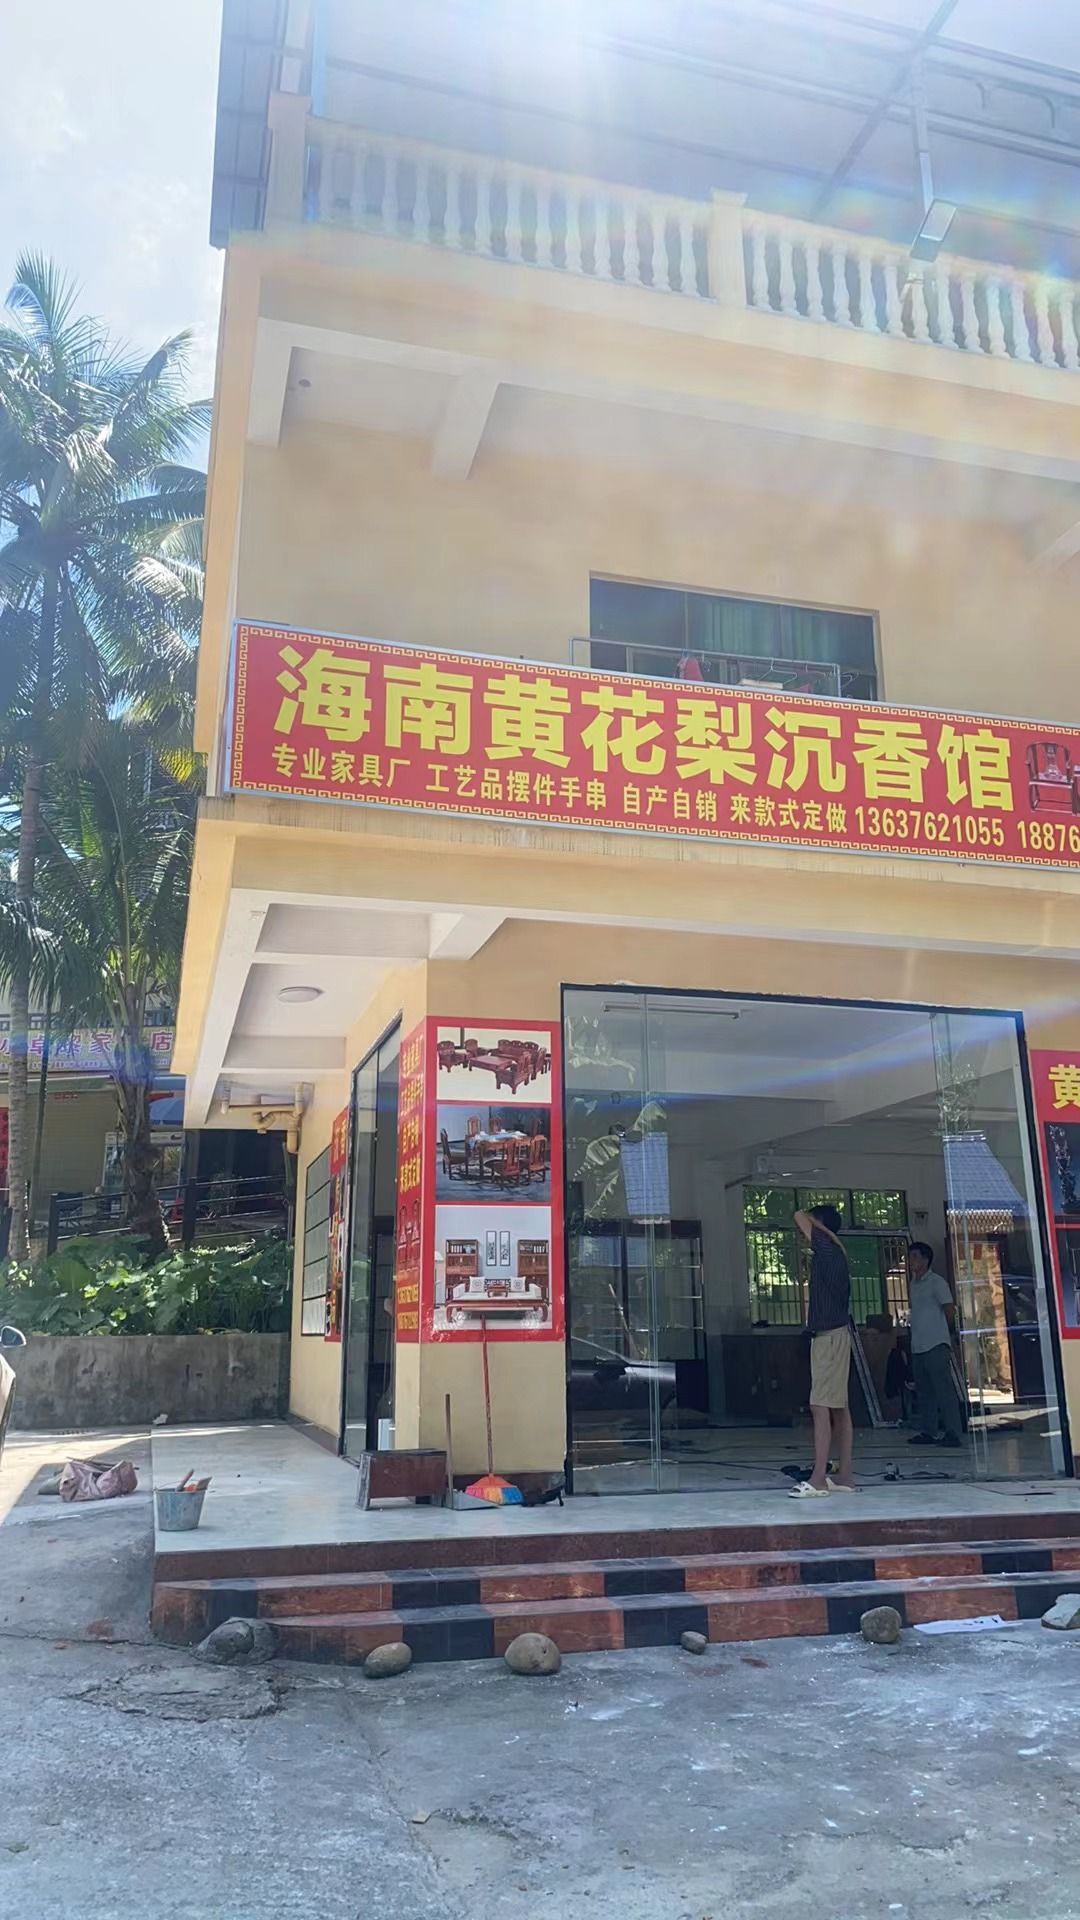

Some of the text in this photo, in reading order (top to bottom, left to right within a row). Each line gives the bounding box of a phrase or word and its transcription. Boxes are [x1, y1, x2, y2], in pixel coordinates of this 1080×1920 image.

[272, 743, 411, 788] 专业家具厂
[426, 763, 607, 811] 工艺品摆件手串
[623, 782, 717, 822] 自产自销
[730, 793, 847, 834] 来款式定做
[855, 806, 1005, 847] 13637621055
[273, 645, 1015, 812] 海南黄花梨沉香馆
